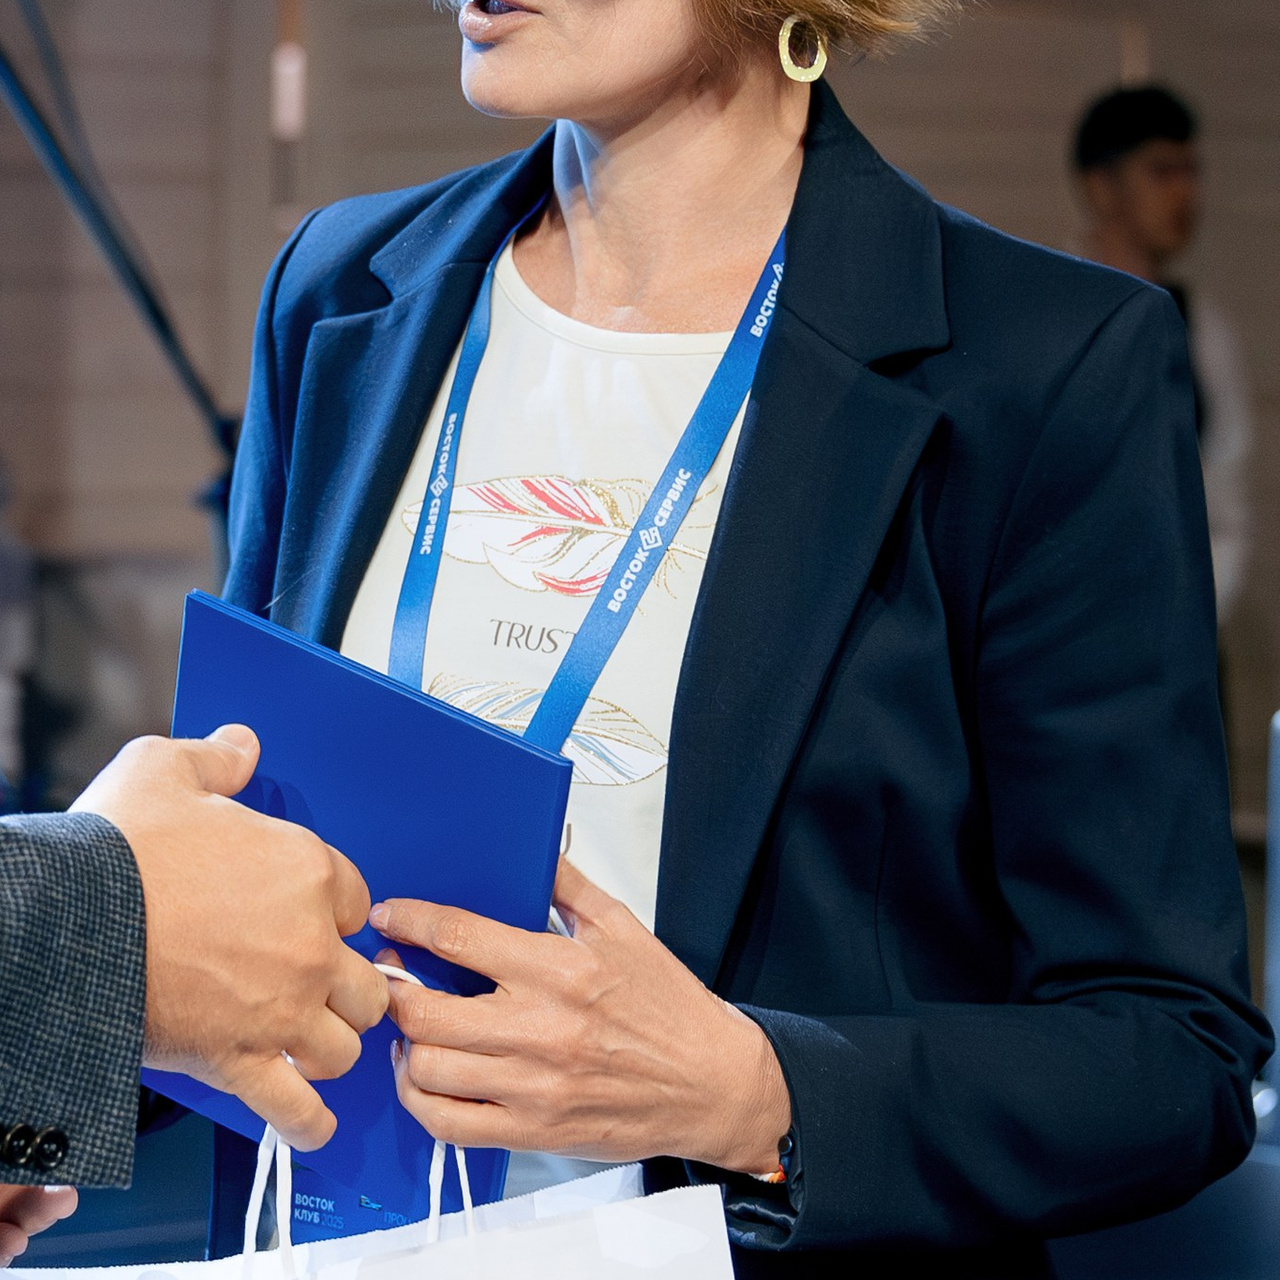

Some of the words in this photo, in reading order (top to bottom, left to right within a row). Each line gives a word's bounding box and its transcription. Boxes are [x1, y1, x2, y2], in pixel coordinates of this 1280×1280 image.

[437, 413, 458, 475] ВОСТОК
[420, 498, 441, 555] СЕРВИС
[607, 547, 650, 613] ВОСТОК
[654, 468, 692, 527] СЕРВИС
[294, 1208, 320, 1224] КЛУБ
[295, 1193, 335, 1212] ВОСТОК
